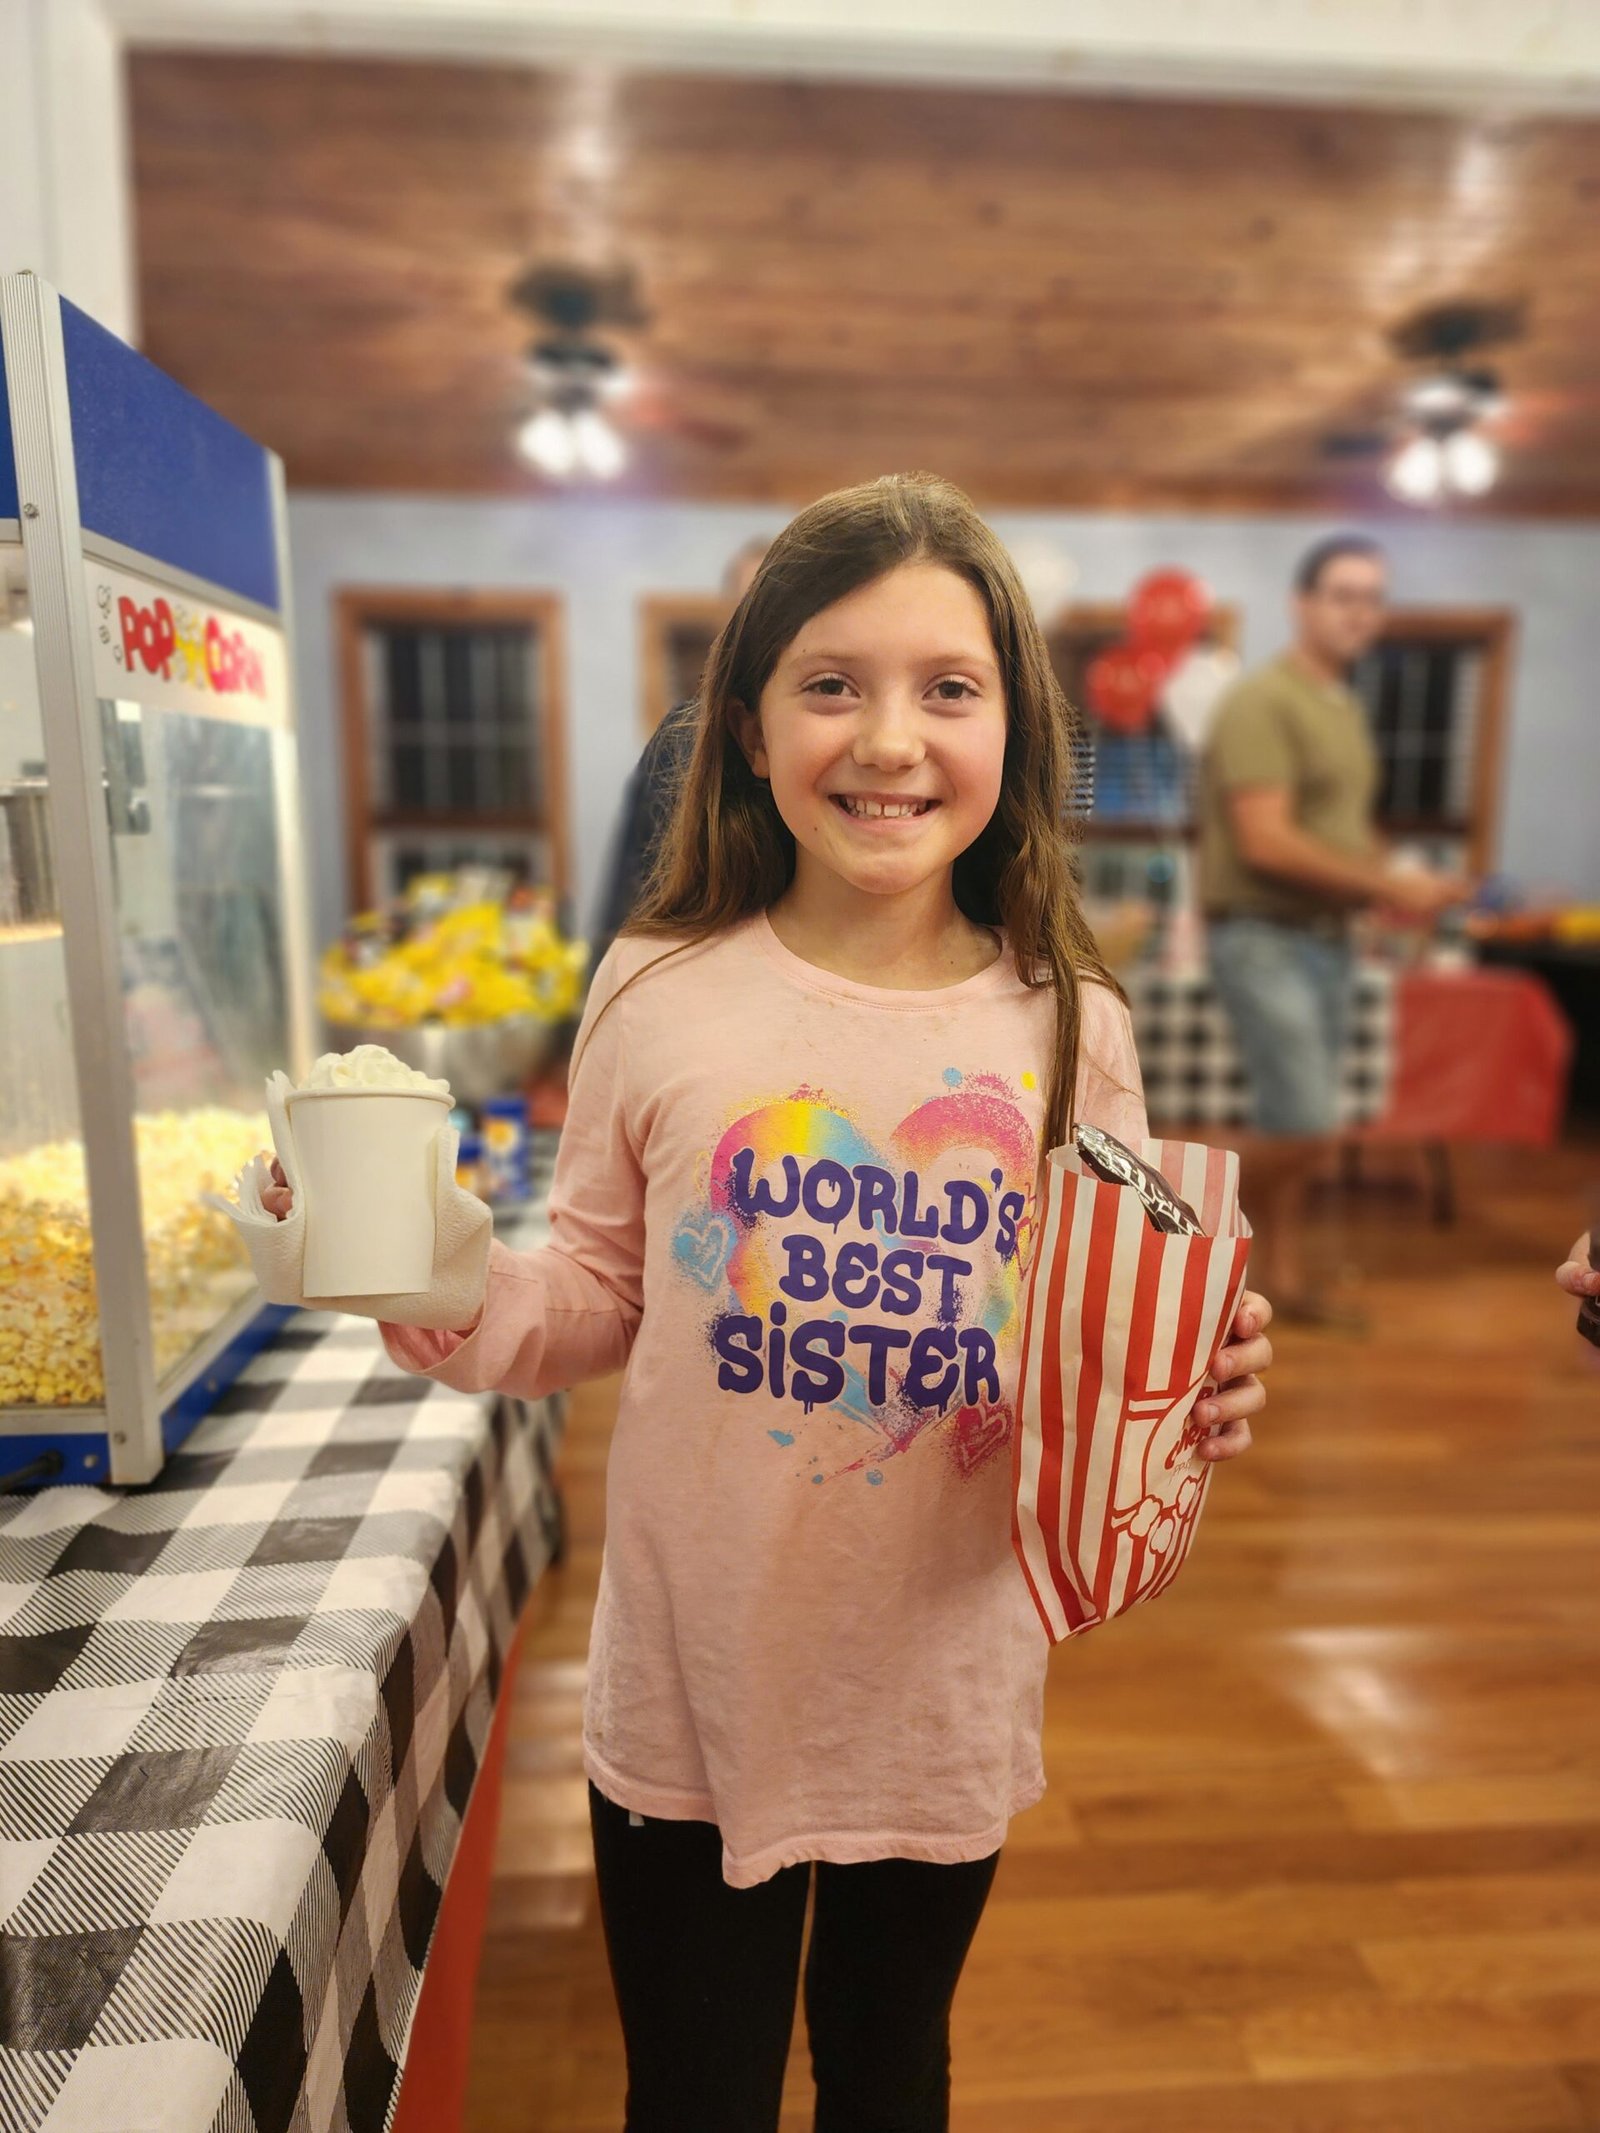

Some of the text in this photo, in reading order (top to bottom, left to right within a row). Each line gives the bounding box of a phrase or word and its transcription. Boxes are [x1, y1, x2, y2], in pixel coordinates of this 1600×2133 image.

[117, 596, 176, 682] POP
[733, 1147, 1025, 1258] WORLD'S
[778, 1234, 973, 1324] BEST
